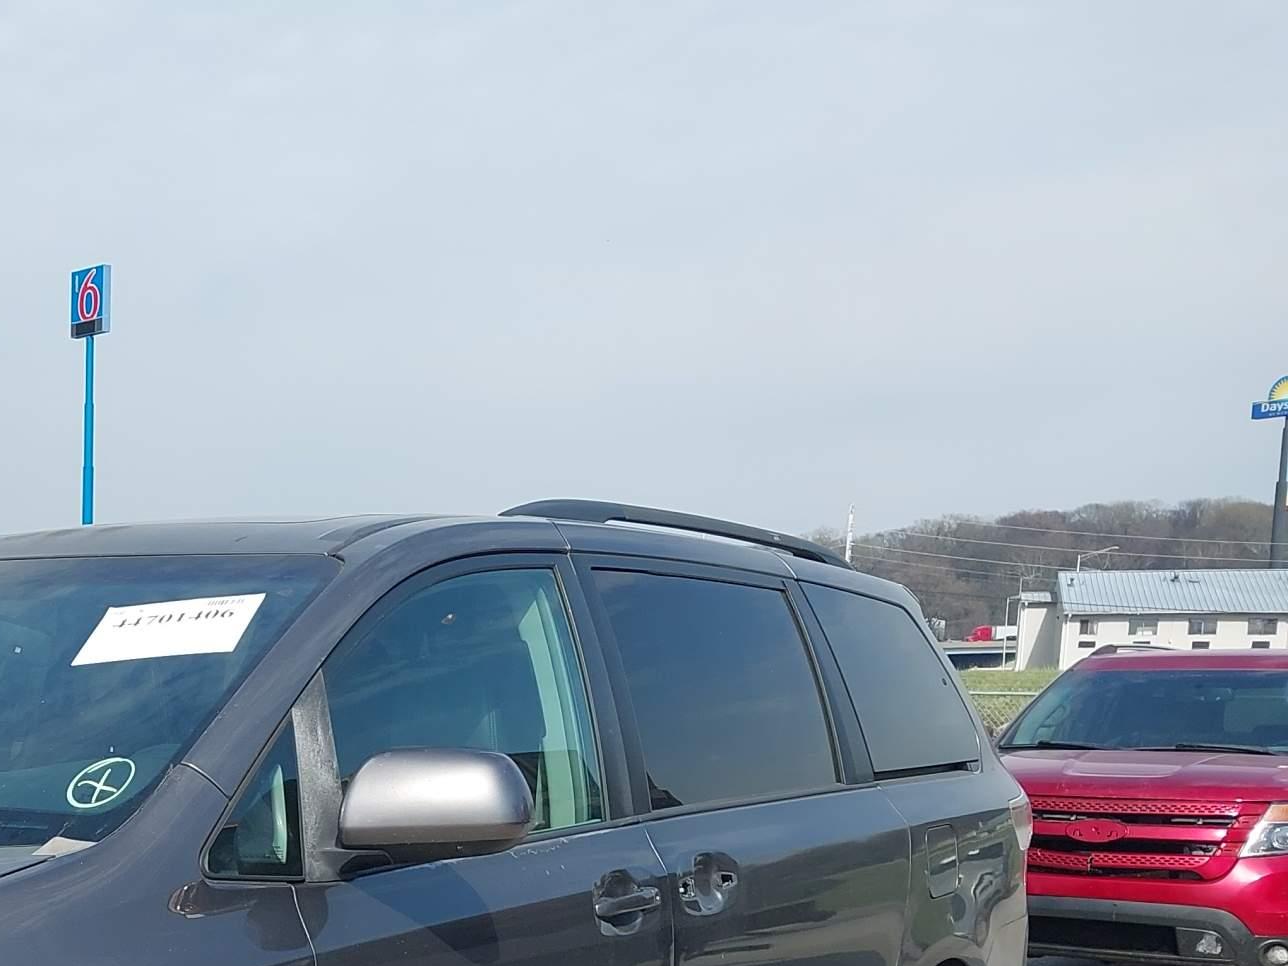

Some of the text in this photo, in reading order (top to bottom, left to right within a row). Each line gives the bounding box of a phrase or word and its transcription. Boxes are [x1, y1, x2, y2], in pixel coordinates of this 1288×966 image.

[78, 268, 99, 321] 6
[1261, 402, 1288, 412] Days
[112, 608, 235, 628] 44701406
